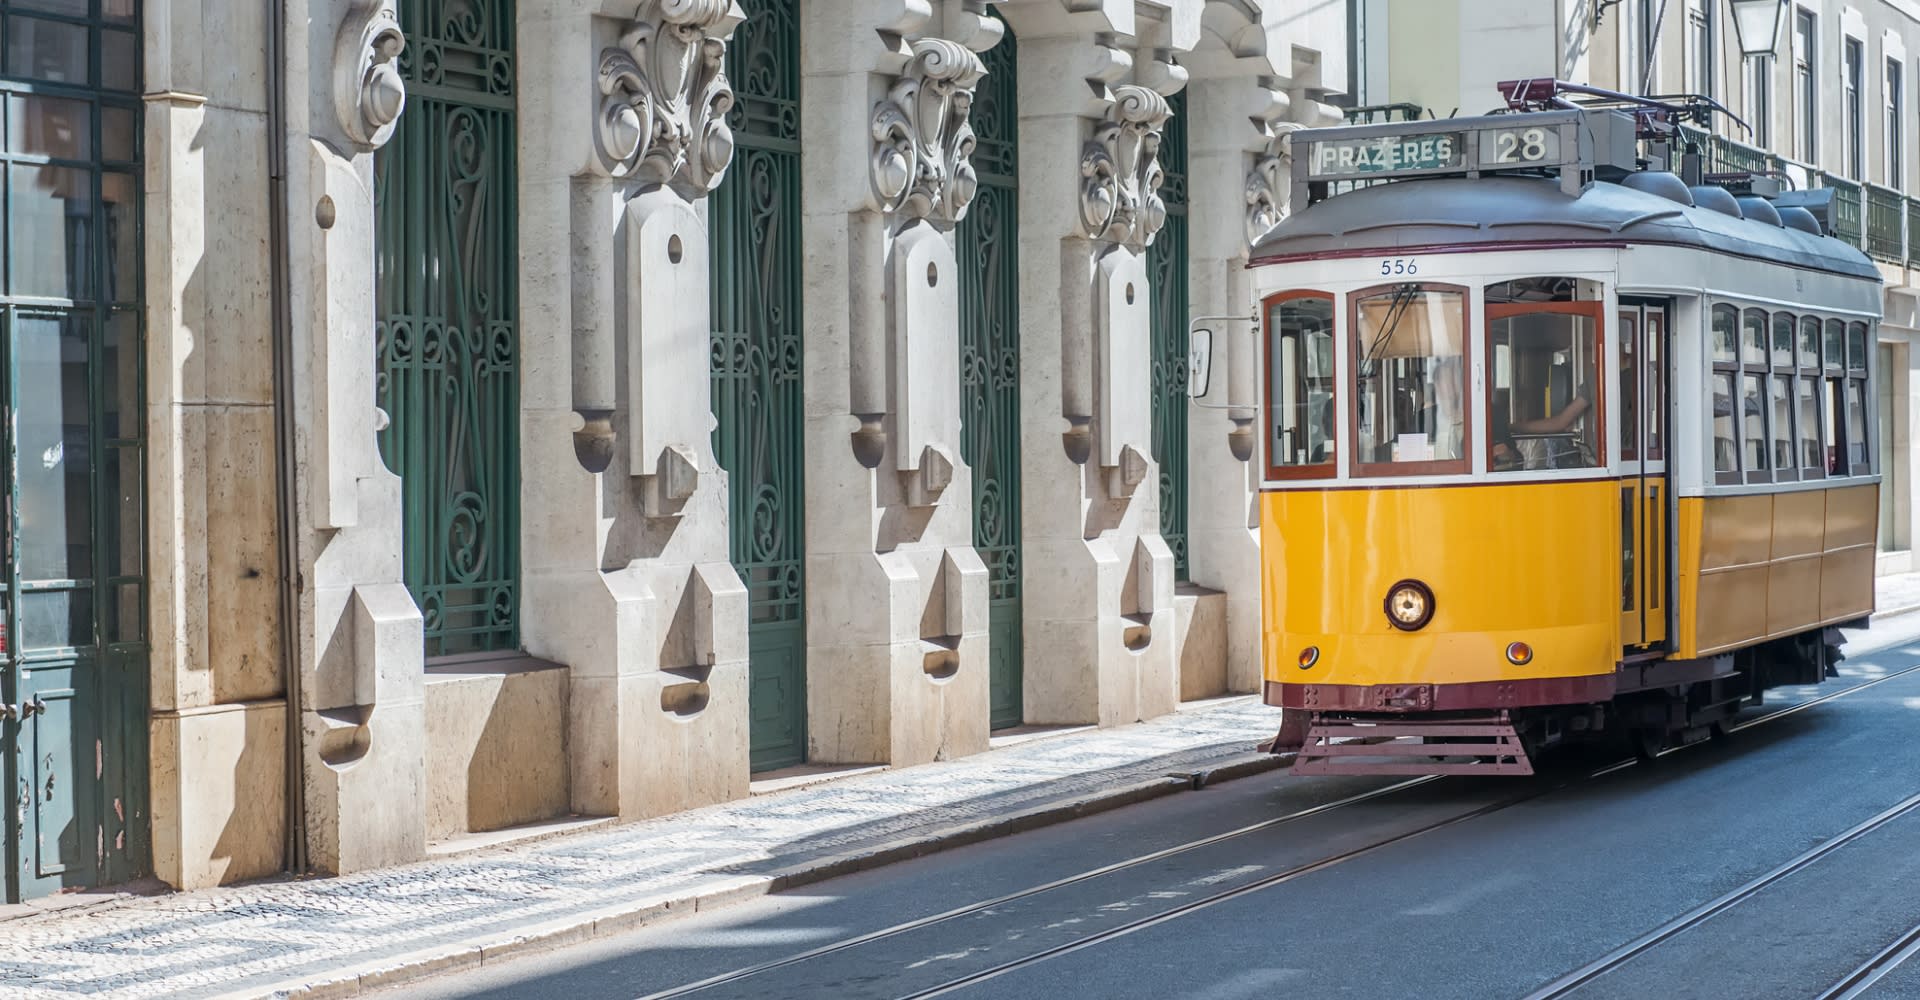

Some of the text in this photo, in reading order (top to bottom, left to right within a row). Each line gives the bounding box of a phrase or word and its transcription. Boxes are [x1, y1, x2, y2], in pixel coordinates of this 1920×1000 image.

[1322, 129, 1546, 168] PRAZERES 28
[1381, 257, 1417, 275] 556
